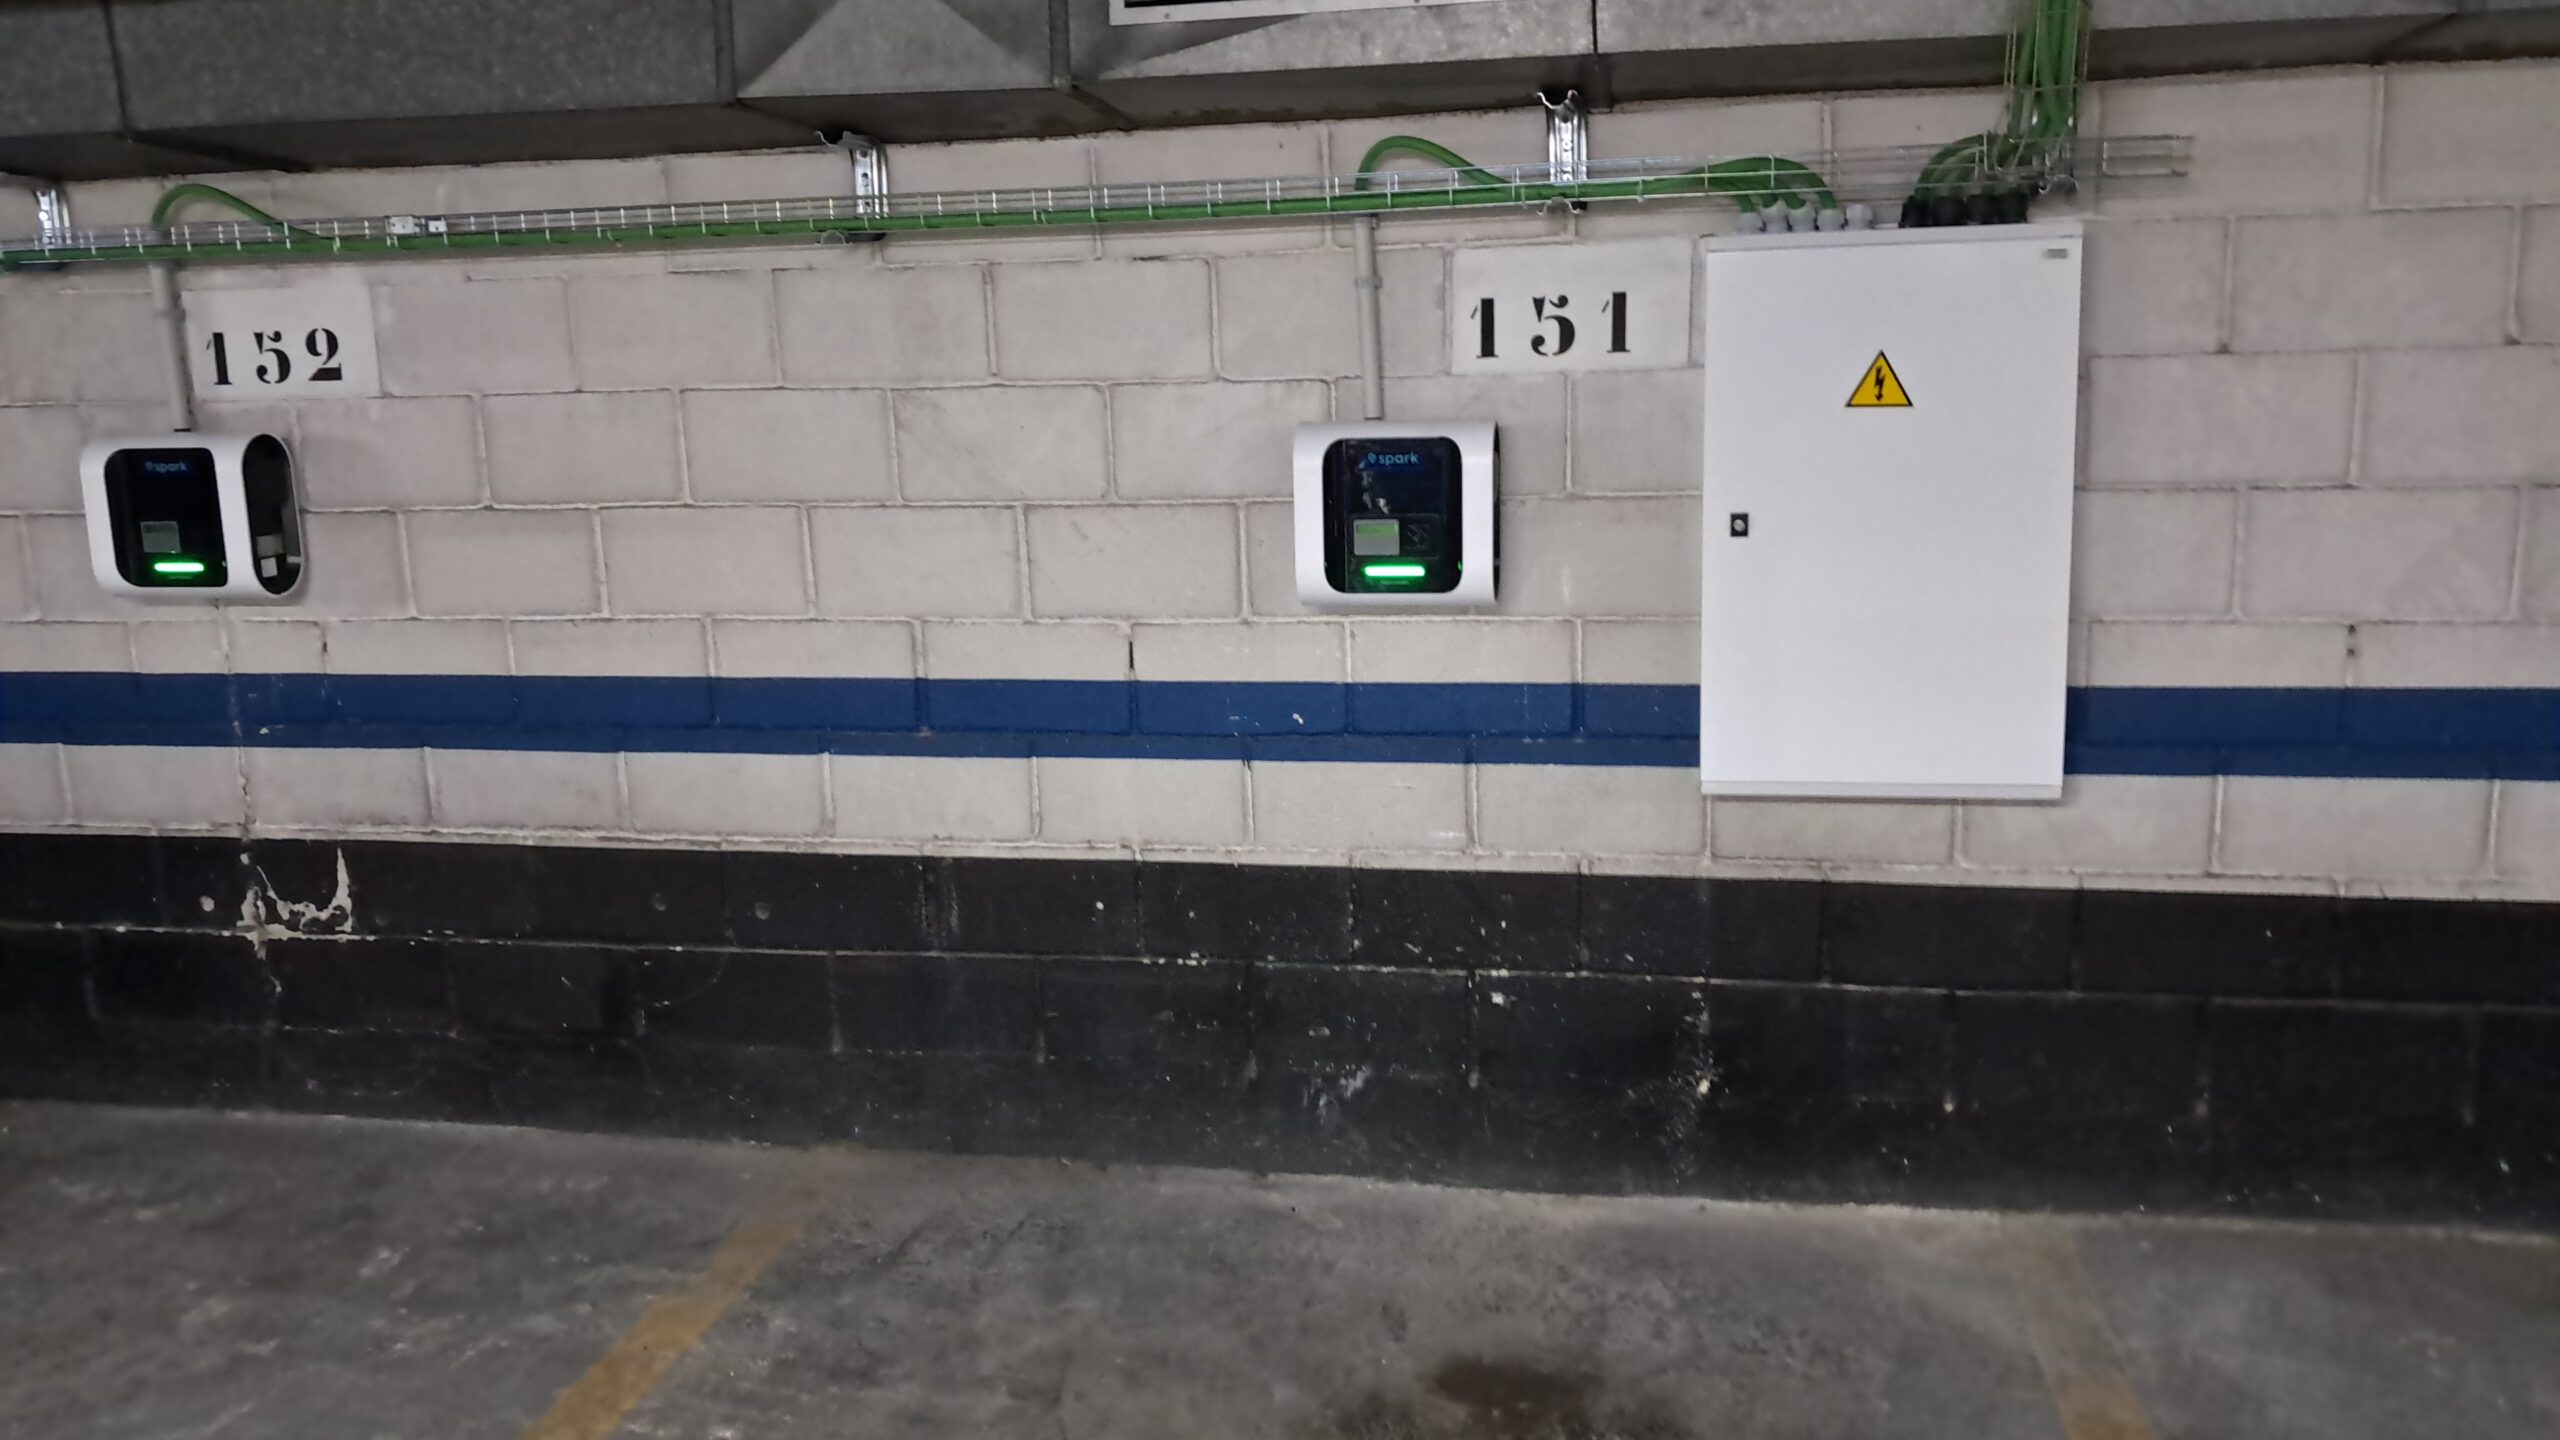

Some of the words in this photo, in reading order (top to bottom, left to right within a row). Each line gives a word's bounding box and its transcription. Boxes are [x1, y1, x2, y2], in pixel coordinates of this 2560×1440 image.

[1470, 291, 1631, 358] 151
[206, 328, 342, 385] 152
[1378, 451, 1419, 466] spark
